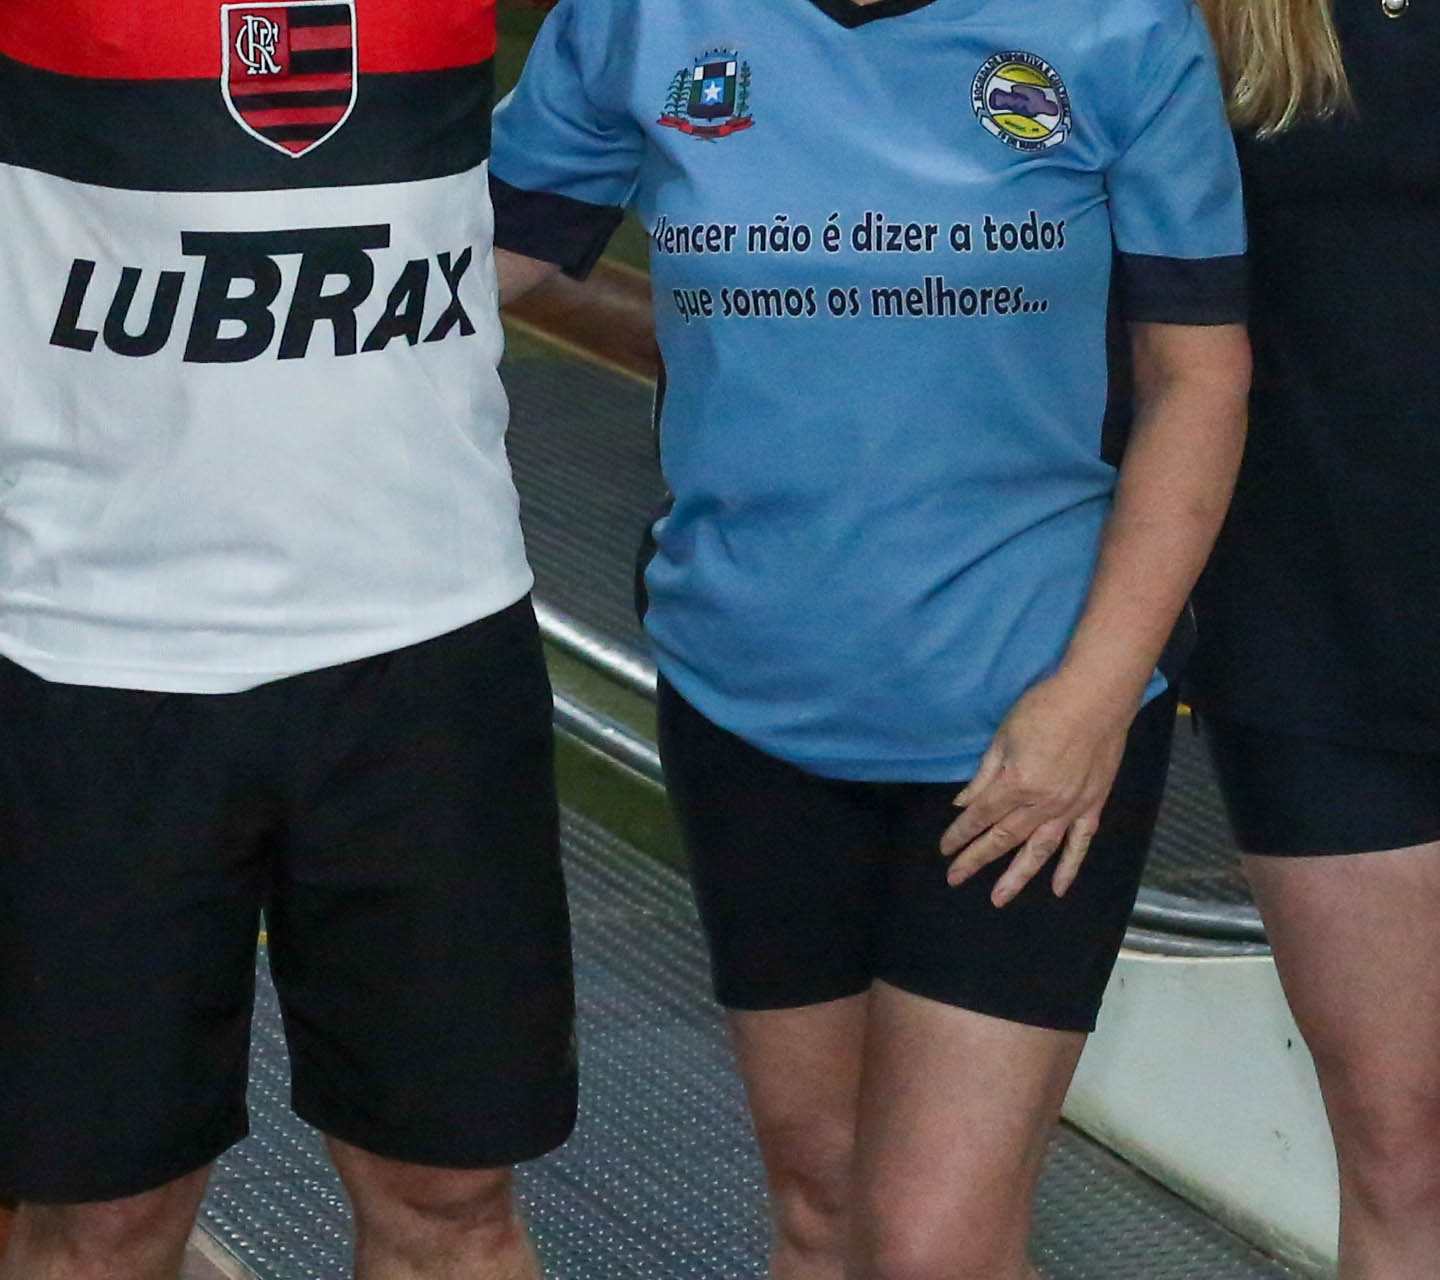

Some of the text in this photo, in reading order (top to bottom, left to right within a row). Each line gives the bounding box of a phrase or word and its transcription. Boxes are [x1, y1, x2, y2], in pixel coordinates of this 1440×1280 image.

[747, 213, 812, 254] não
[822, 211, 841, 253] é
[851, 210, 939, 253] dizer
[949, 222, 972, 253] a
[983, 209, 1066, 252] todos
[50, 222, 477, 364] LUBRAX
[672, 275, 1049, 324] que somos os melhores...
